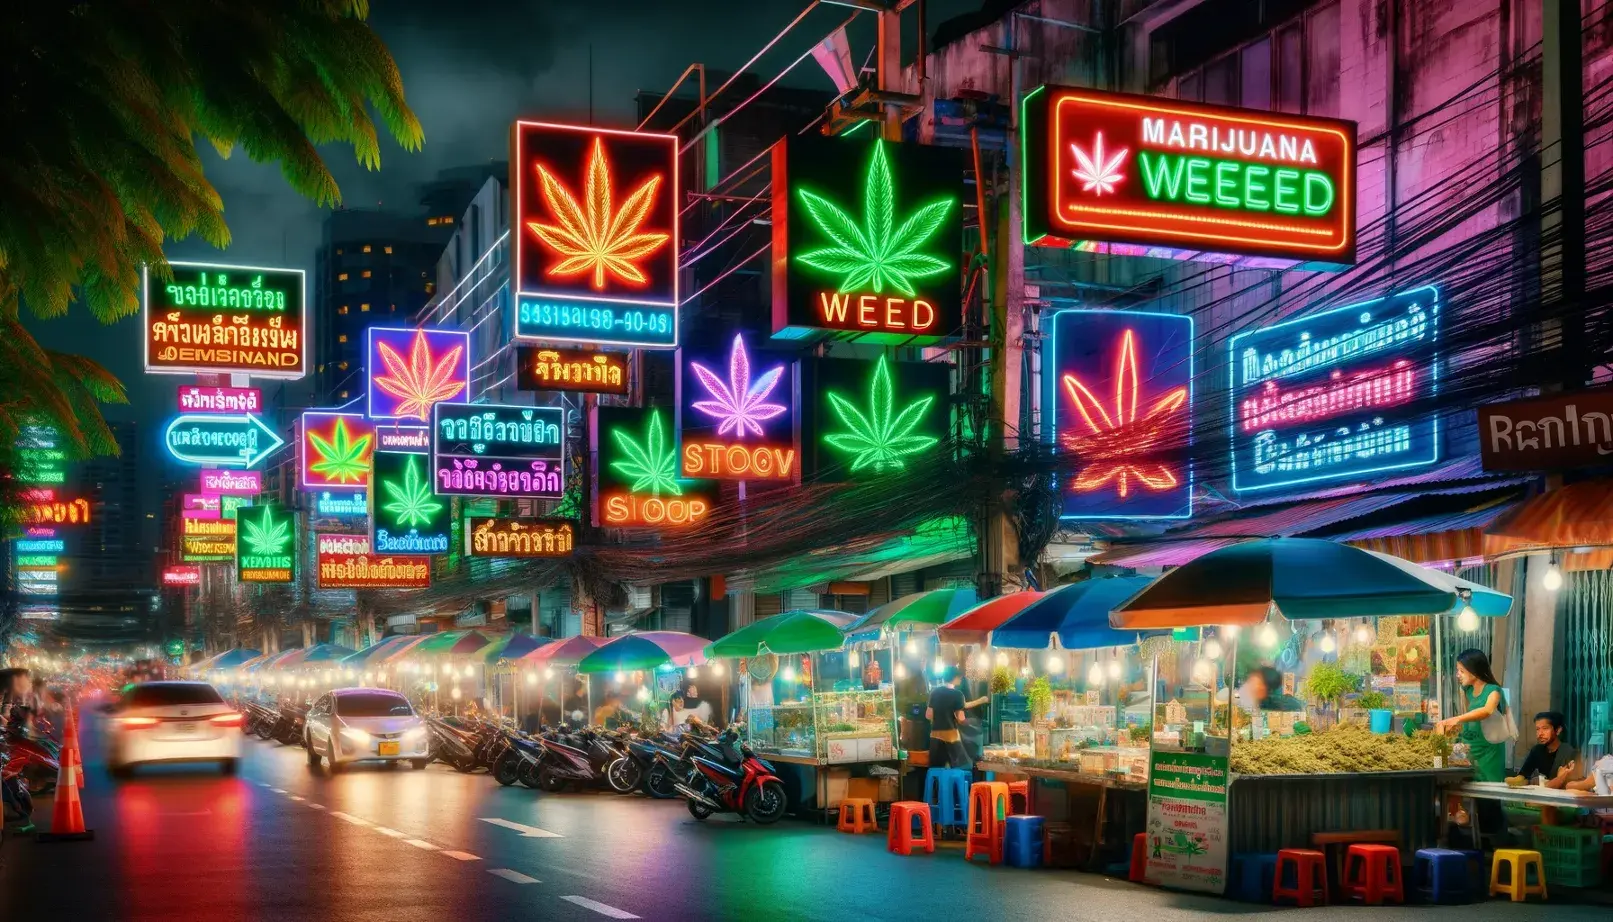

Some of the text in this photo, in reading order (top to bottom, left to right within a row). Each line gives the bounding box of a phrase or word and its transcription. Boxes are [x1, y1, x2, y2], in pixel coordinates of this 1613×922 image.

[1142, 117, 1317, 163] MARIJUANA
[1138, 152, 1335, 215] WEEEED
[820, 292, 935, 330] WEED
